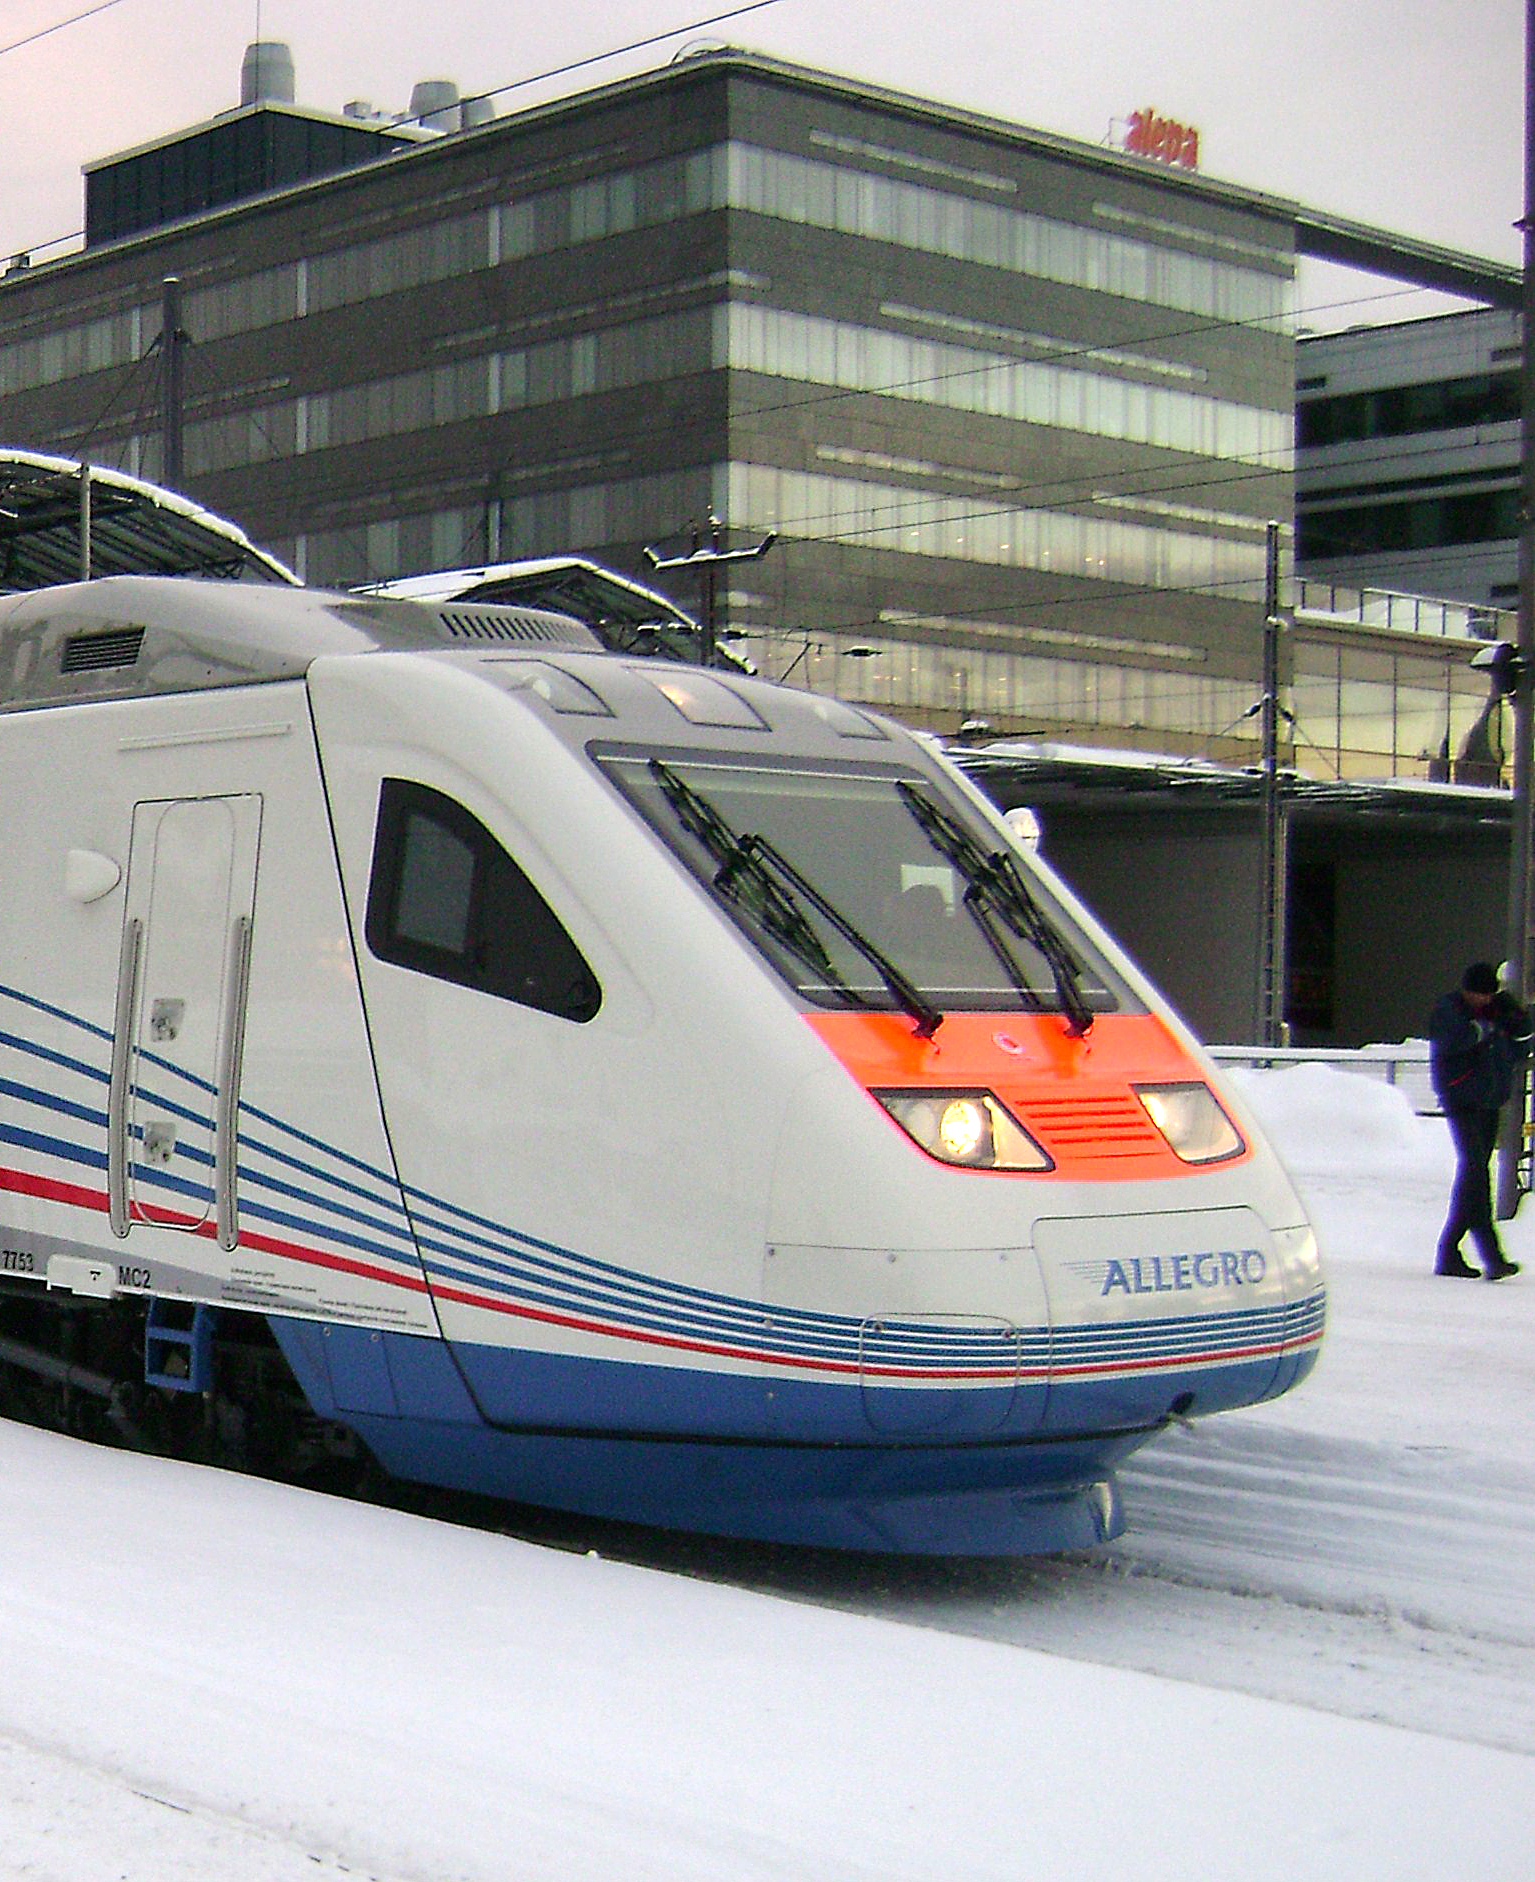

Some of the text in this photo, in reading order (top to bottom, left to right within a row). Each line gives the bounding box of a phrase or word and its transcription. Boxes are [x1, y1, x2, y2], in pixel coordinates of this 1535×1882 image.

[2, 1249, 34, 1272] 7753
[1101, 1249, 1266, 1296] ALLEGRO
[118, 1265, 152, 1289] MC2
